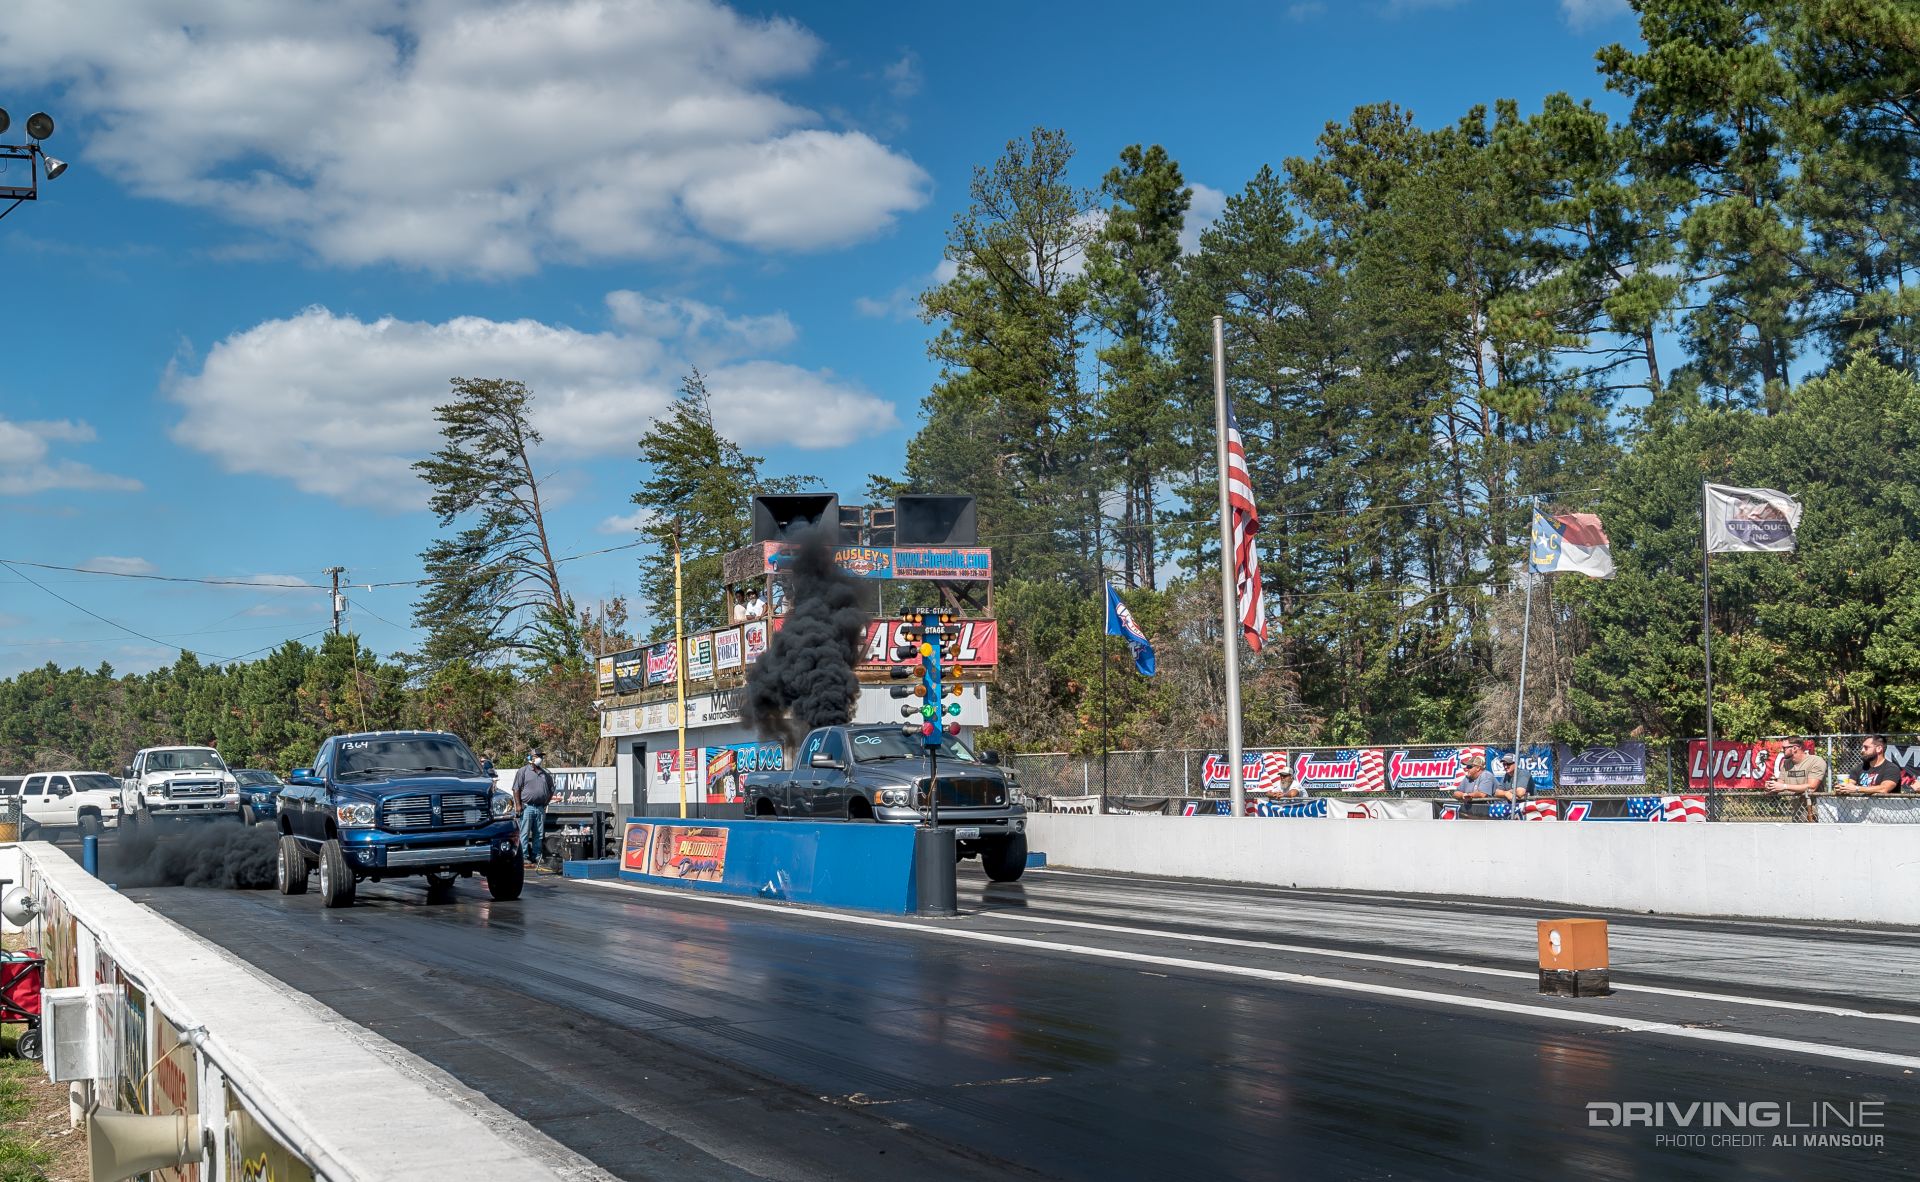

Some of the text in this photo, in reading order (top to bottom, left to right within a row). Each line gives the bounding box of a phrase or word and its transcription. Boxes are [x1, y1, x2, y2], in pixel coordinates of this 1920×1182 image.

[1728, 523, 1745, 531] OIL
[1752, 533, 1771, 541] INC.
[834, 549, 890, 566] AUSLEY'S
[916, 607, 953, 615] PRE-STAGE
[924, 626, 945, 634] STAGE
[717, 643, 739, 661] FORCE
[341, 741, 369, 750] 1364
[854, 735, 882, 745] 06
[737, 744, 784, 773] BIG DOG
[1691, 750, 1768, 779] LUCAS
[567, 773, 595, 790] MAVTV
[679, 840, 721, 857] PIEDMONT
